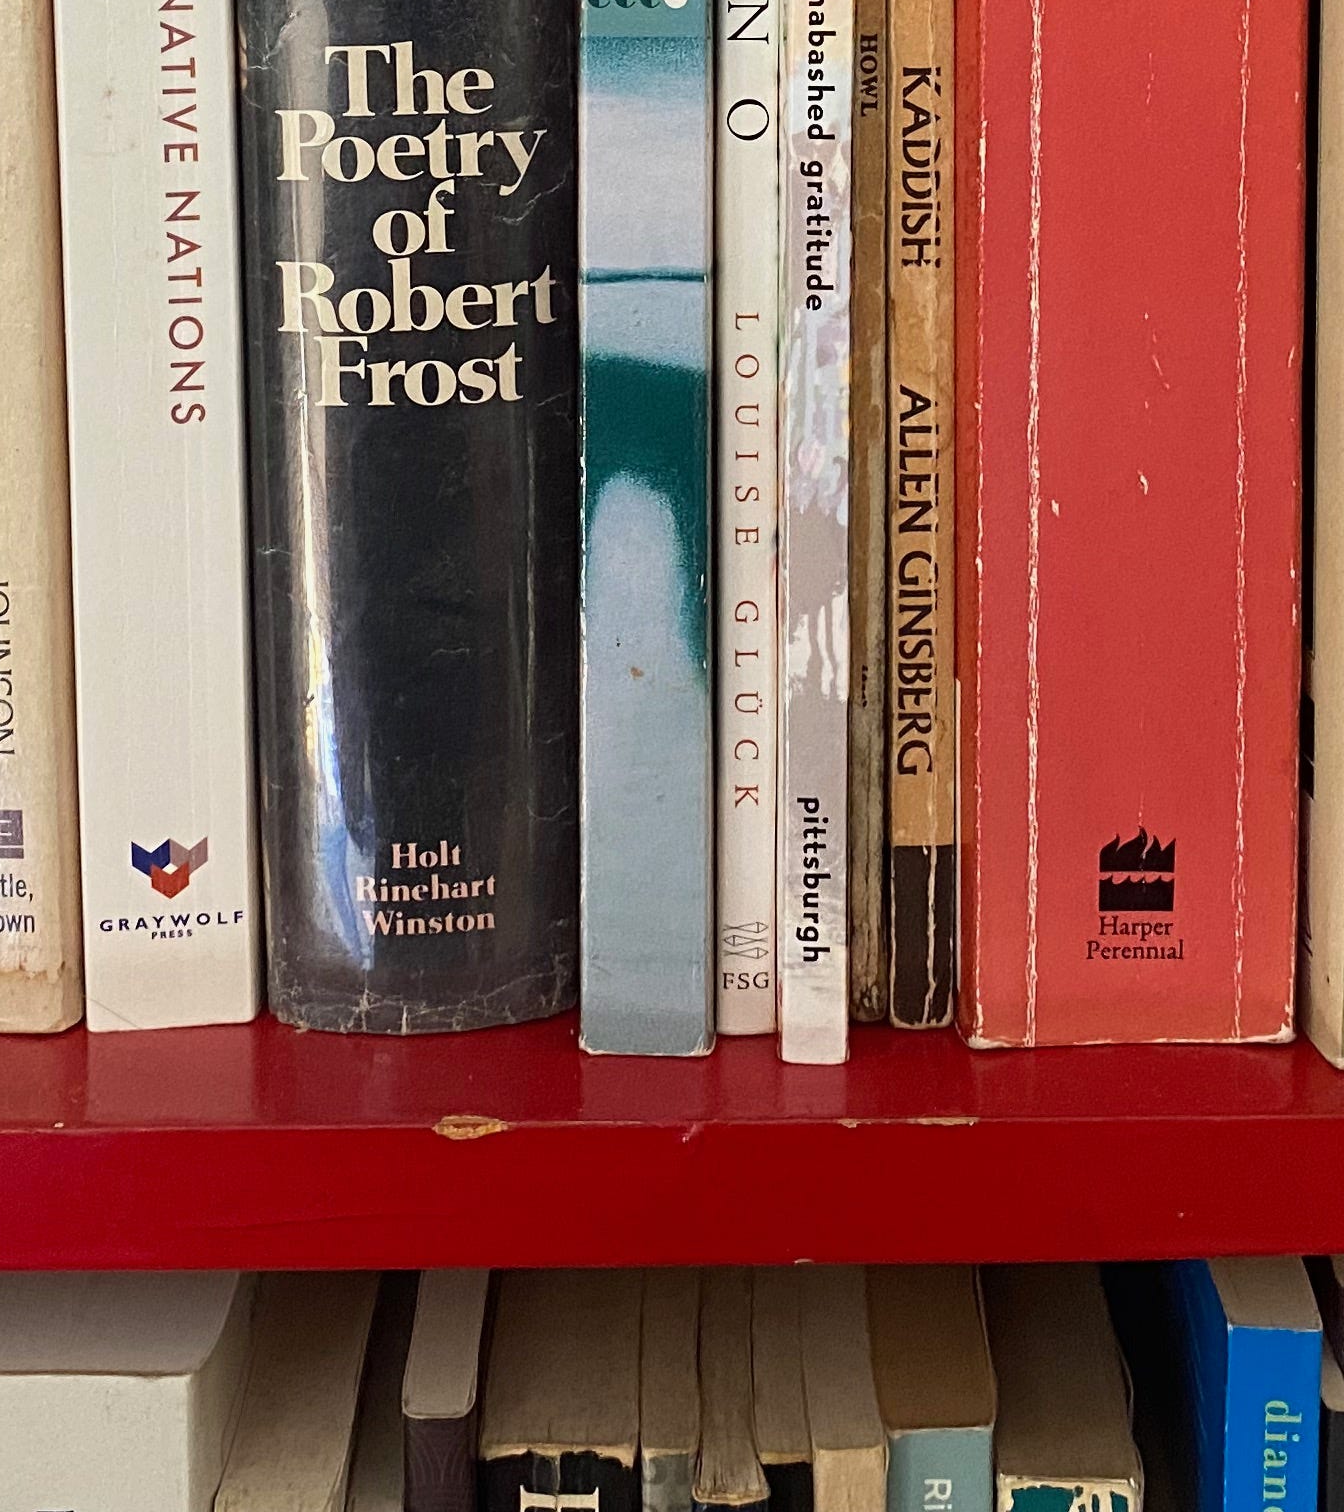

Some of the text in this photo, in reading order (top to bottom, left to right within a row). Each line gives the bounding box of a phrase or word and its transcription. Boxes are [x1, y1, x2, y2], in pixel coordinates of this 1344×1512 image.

[325, 42, 494, 118] The
[860, 33, 878, 116] HOWL
[276, 110, 546, 196] Poetry
[900, 67, 940, 268] KADDISH
[373, 180, 456, 254] of
[801, 160, 835, 311] gratitude
[167, 190, 205, 426] NATIONS
[278, 259, 557, 332] Robert
[315, 336, 522, 407] Frost
[897, 384, 936, 777] ALLEN GINSBERG
[354, 873, 497, 902] Rinehart
[391, 842, 461, 868] Holt
[797, 795, 832, 963] pittsburgh
[100, 910, 244, 933] GRAYWOLF
[362, 904, 495, 936] Winston
[1086, 941, 1184, 961] Perennial
[1097, 915, 1174, 941] Harper
[722, 972, 770, 989] FSG
